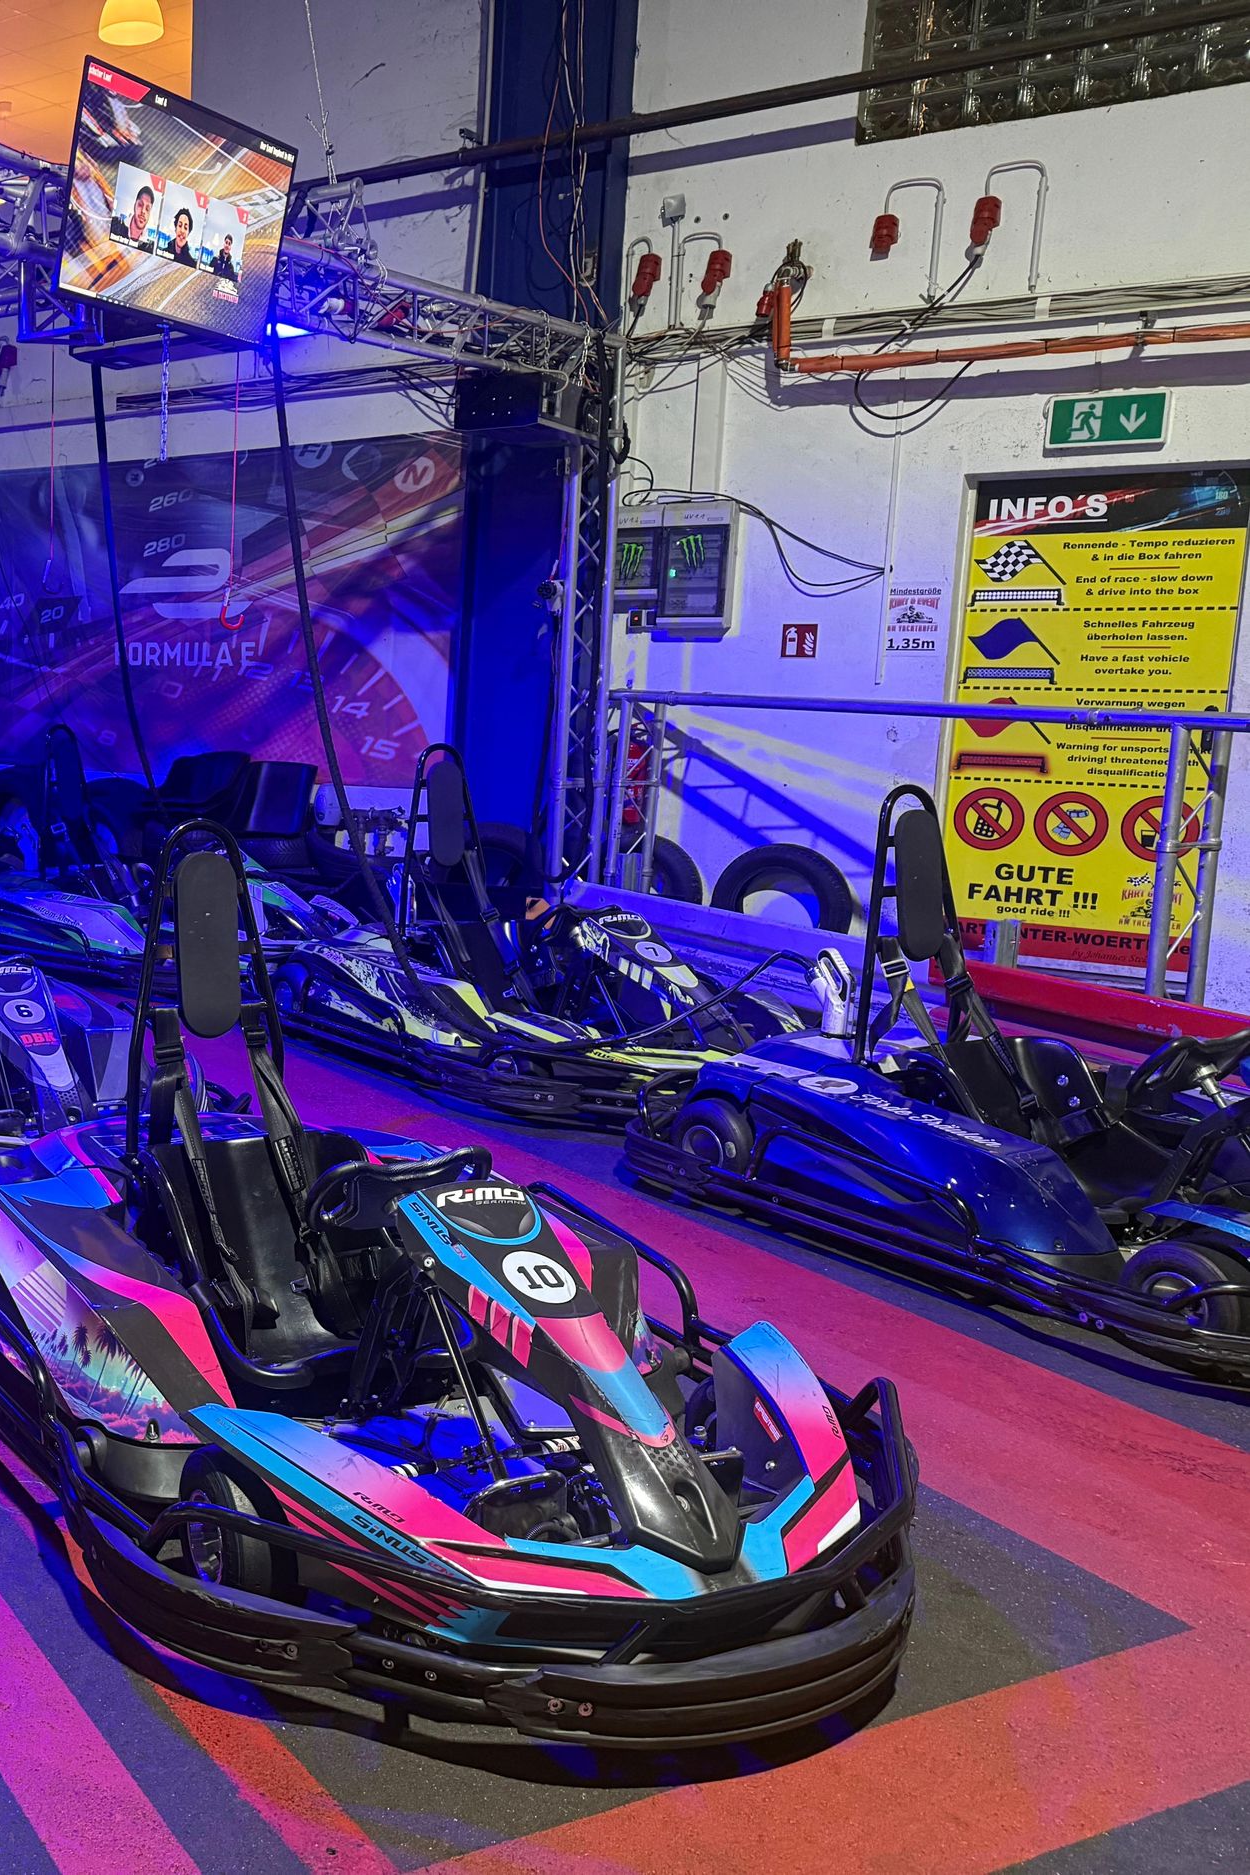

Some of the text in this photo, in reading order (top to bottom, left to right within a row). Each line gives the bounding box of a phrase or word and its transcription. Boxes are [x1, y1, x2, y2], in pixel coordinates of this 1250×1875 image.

[148, 489, 193, 513] 260
[143, 533, 186, 558] 280
[1062, 541, 1119, 550] Rennende
[1129, 539, 1169, 550] Tempo
[1171, 538, 1236, 547] reduzieren
[1103, 553, 1114, 562] in
[1116, 552, 1134, 561] die
[1138, 552, 1160, 561] Box
[1163, 551, 1202, 561] fahren
[1075, 575, 1097, 583] End
[1099, 574, 1112, 583] of
[1150, 574, 1176, 582] slow
[1180, 574, 1213, 582] down
[1097, 587, 1126, 596] drive
[1129, 587, 1152, 595] into
[1155, 587, 1177, 595] the
[1179, 587, 1199, 595] box
[39, 606, 65, 625] 20
[1083, 620, 1195, 630] Schnelles Fahrzeug
[1086, 632, 1188, 641] überholen lassen.
[886, 638, 935, 650] 1,35m
[1080, 654, 1108, 662] Have
[1122, 654, 1145, 662] fast
[1148, 654, 1190, 662] vehicle
[1094, 667, 1172, 677] overtake you.
[332, 695, 370, 720] 14
[1076, 698, 1185, 708] Verwarnung wegen
[359, 735, 401, 761] 15
[1056, 743, 1099, 753] Warning
[1102, 744, 1118, 753] for
[1067, 755, 1107, 765] driving!
[1087, 767, 1167, 779] disqualificatio
[994, 864, 1074, 886] GUTE
[967, 883, 1099, 911] FAHRT !!!
[996, 905, 1028, 916] good
[1029, 906, 1055, 917] ride
[15, 1004, 34, 1018] 6
[516, 1264, 566, 1290] 10
